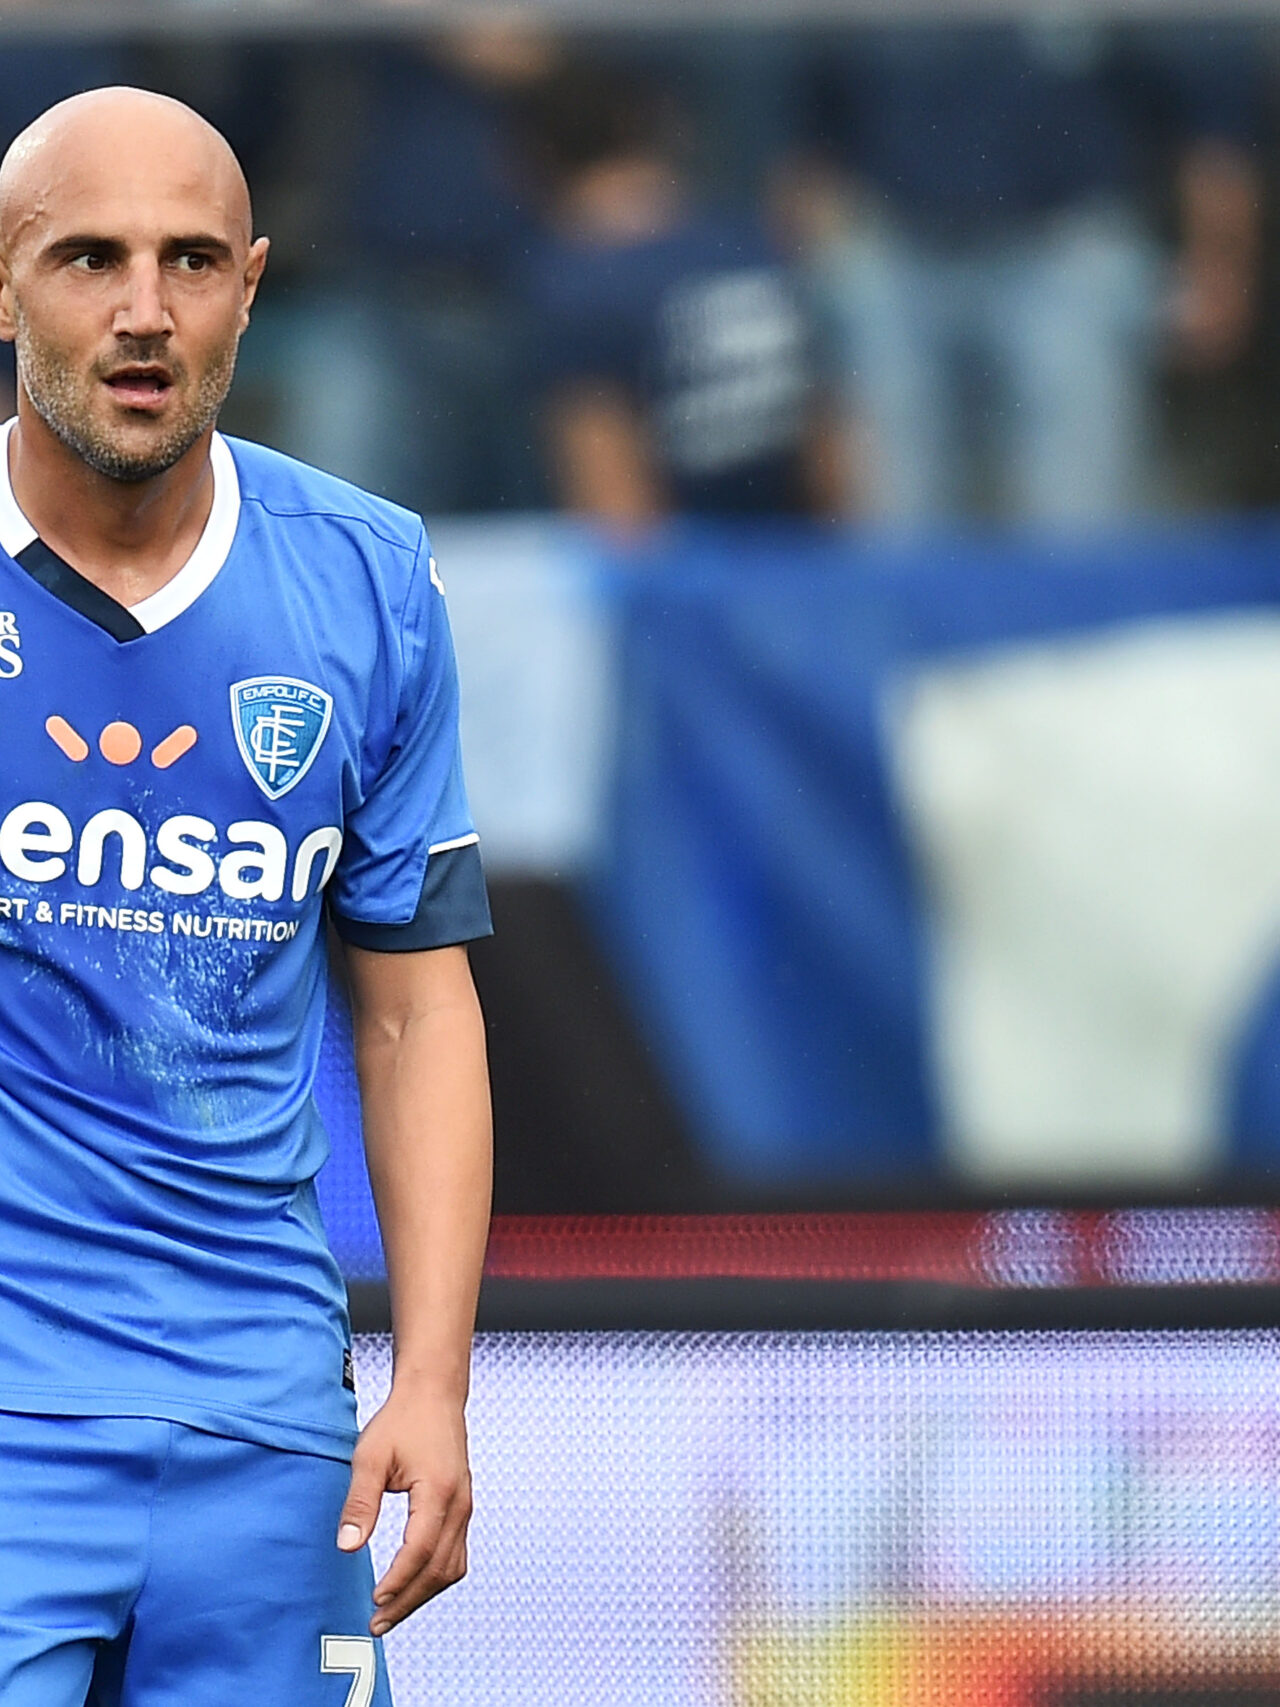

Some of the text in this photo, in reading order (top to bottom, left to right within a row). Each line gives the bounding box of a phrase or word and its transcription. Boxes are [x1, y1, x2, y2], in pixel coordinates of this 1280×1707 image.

[242, 685, 298, 701] EMPOLI
[35, 901, 53, 923] &
[60, 902, 165, 934] FITNESS
[172, 912, 300, 943] NUTRITION
